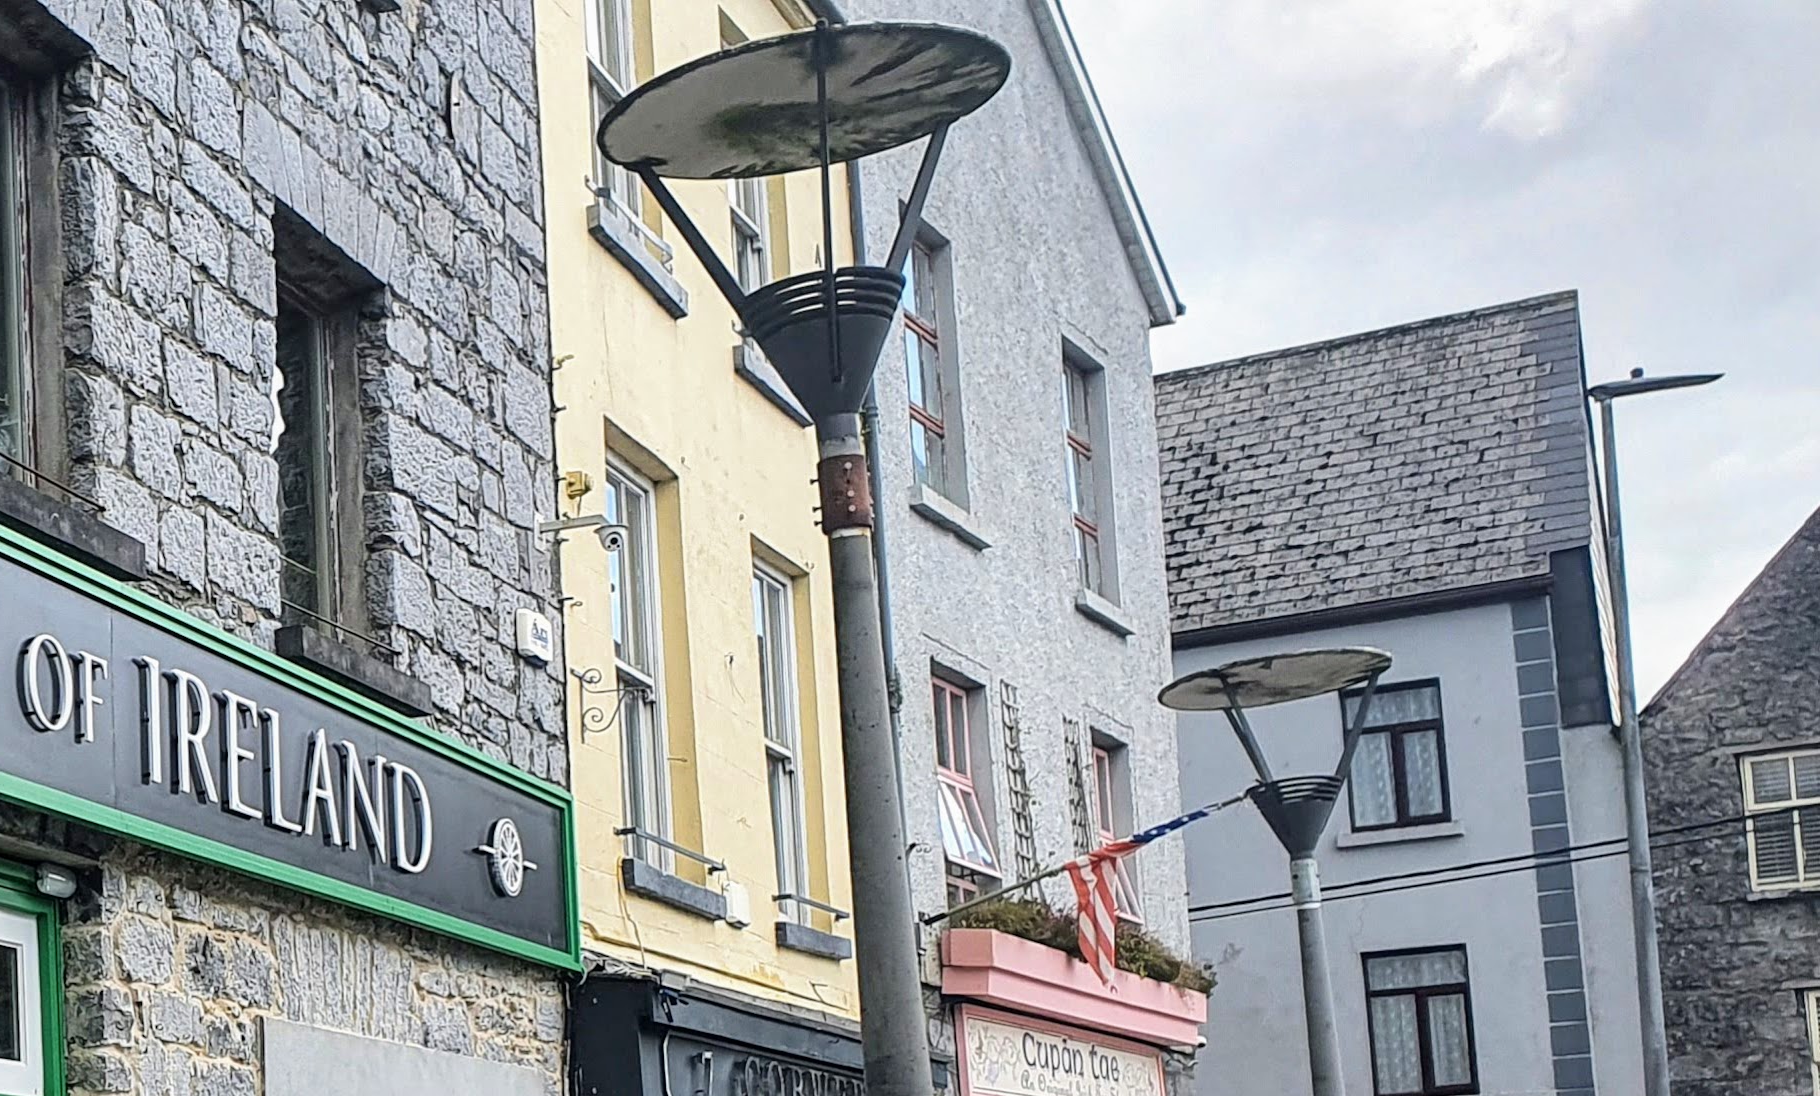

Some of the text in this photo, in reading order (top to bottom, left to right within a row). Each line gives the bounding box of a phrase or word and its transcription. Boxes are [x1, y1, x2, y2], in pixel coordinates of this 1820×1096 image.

[24, 633, 109, 743] OF
[138, 655, 434, 874] IRELAND
[1089, 1044, 1121, 1083] tae
